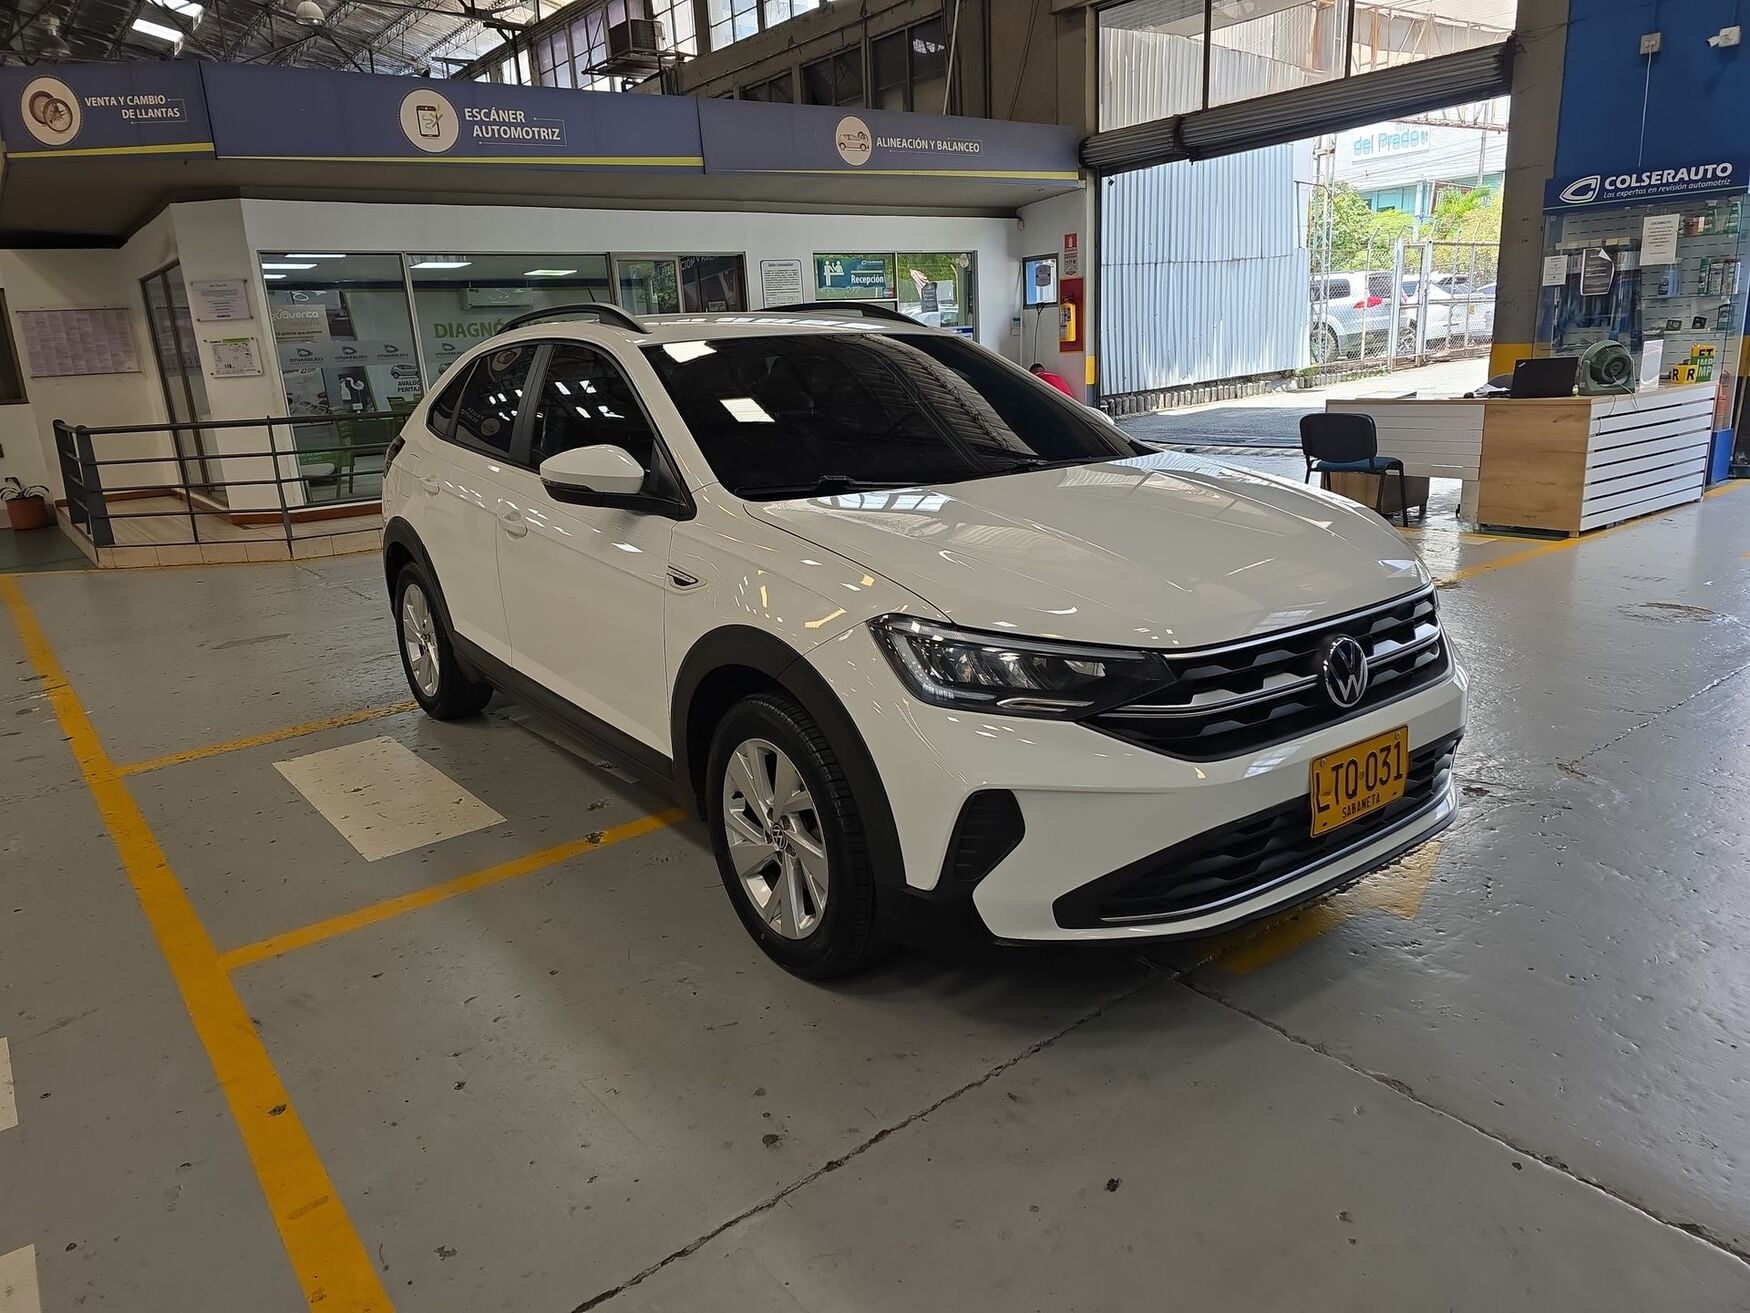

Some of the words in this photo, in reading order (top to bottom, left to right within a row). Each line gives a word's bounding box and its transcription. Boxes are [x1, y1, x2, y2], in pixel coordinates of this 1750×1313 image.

[84, 96, 118, 107] VENTA
[118, 96, 125, 106] Y
[126, 94, 166, 105] CAMBIO
[121, 109, 136, 119] DE
[136, 107, 180, 119] LLANTAS
[464, 106, 526, 123] ESCÁNER
[473, 125, 561, 140] AUTOMOTRIZ
[876, 137, 928, 149] ALINEACIÓN
[930, 140, 936, 150] Y
[936, 140, 980, 153] BALANCEO
[1604, 162, 1733, 190] COLSERAUTO
[1603, 191, 1615, 199] Los
[1616, 188, 1647, 198] expertos
[1658, 183, 1687, 192] revisión
[1688, 178, 1731, 189] automotriz
[850, 274, 884, 286] Recepción
[1686, 368, 1696, 381] R
[1342, 792, 1381, 819] SABANETA
